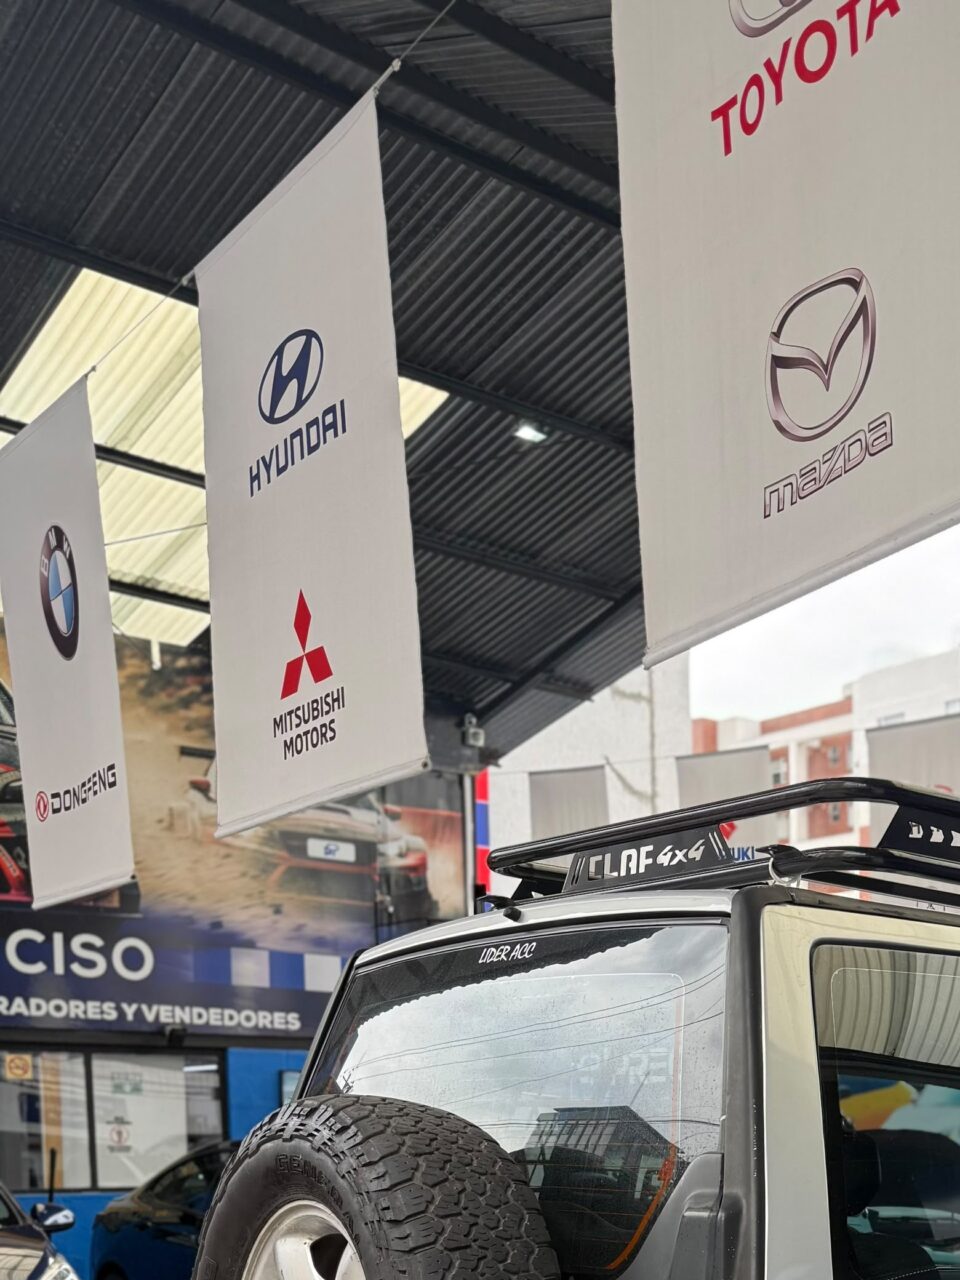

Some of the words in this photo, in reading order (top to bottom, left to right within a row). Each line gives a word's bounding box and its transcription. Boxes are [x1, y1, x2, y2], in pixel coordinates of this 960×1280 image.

[711, 0, 900, 157] TOYOTA
[249, 399, 347, 497] HYUNDAI
[272, 687, 346, 739] MITSUBISHI
[283, 722, 337, 760] MOTORS
[51, 763, 117, 814] DONGFENG
[656, 839, 706, 867] 4x4
[5, 928, 154, 981] CISO
[478, 945, 511, 964] LIDER
[509, 942, 537, 960] ACC
[119, 1003, 142, 1020] Y
[141, 1004, 301, 1030] VENDEDORES
